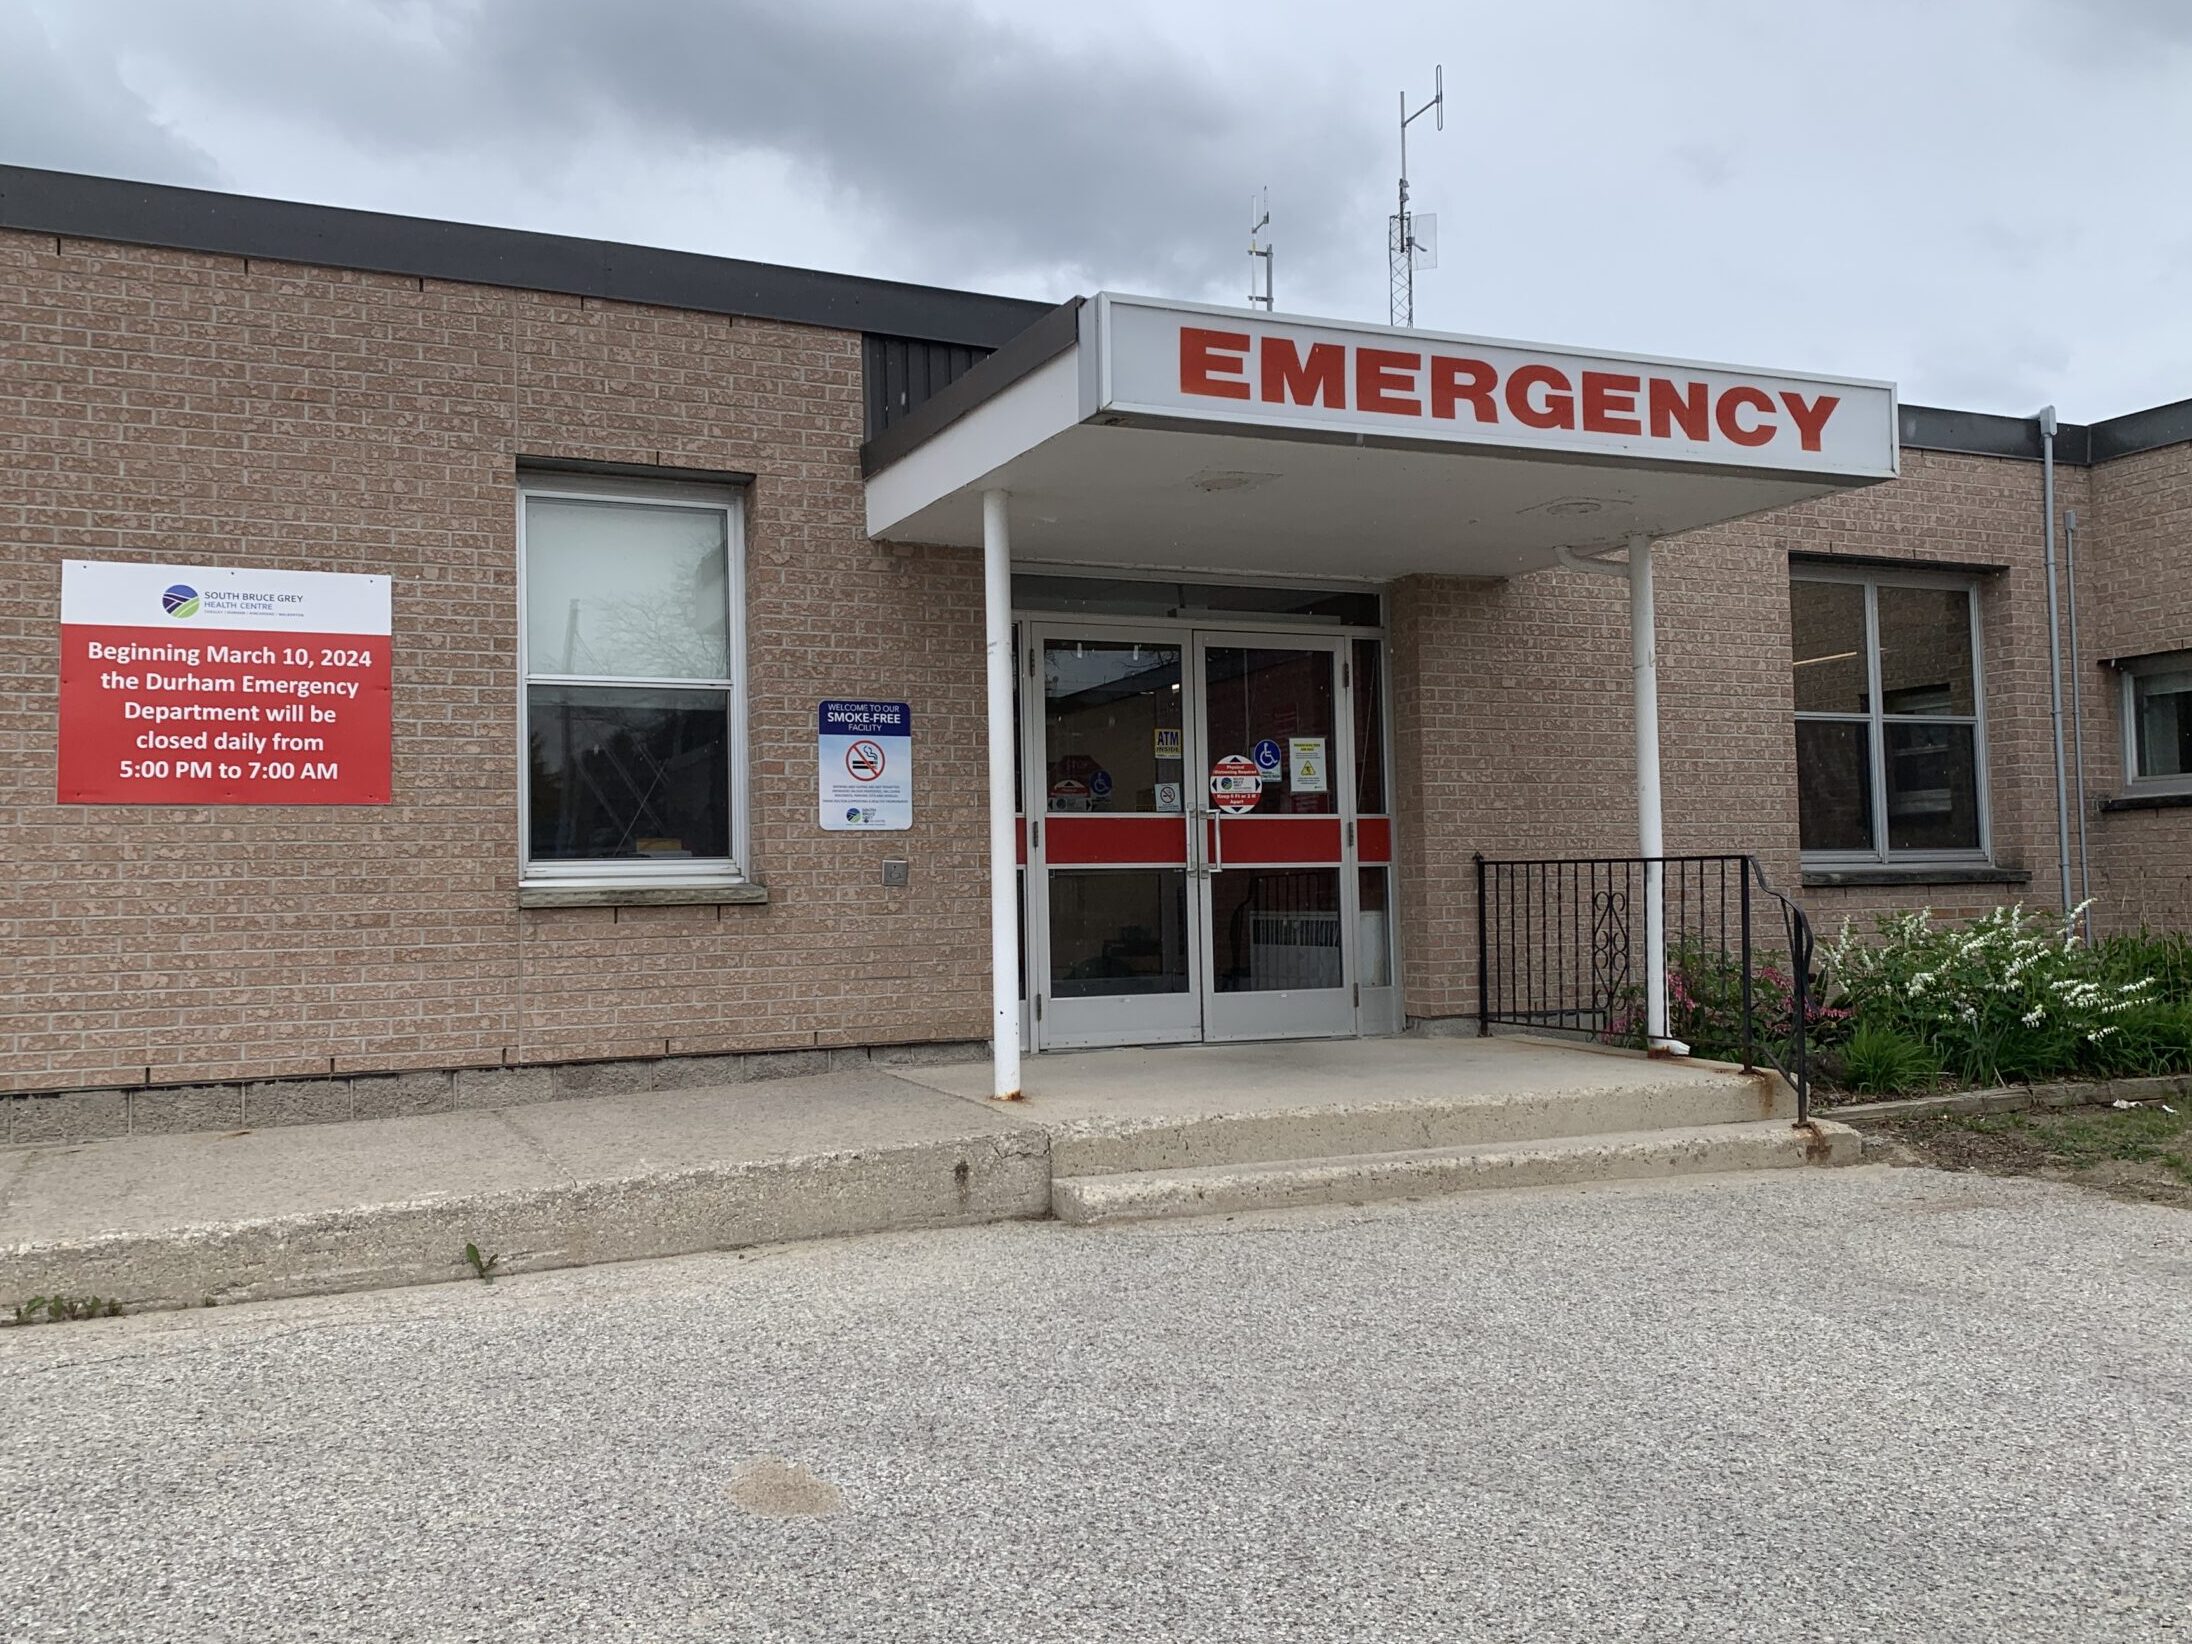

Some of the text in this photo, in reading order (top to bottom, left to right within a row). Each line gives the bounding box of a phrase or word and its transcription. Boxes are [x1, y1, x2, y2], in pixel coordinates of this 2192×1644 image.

[1179, 326, 1838, 452] EMERGENCY
[205, 592, 239, 600] SOUTH
[242, 593, 274, 601] BRUCE
[89, 642, 372, 668] Beginning March 10, 2024
[101, 671, 358, 698] the Durham Emergency
[125, 702, 336, 723] Department will be
[828, 712, 900, 723] SMOKE-FREE
[870, 704, 881, 712] TO
[137, 731, 323, 754] closed daily from
[1158, 731, 1179, 745] ATM
[120, 761, 337, 779] 5:00 PM to 7:00 AM
